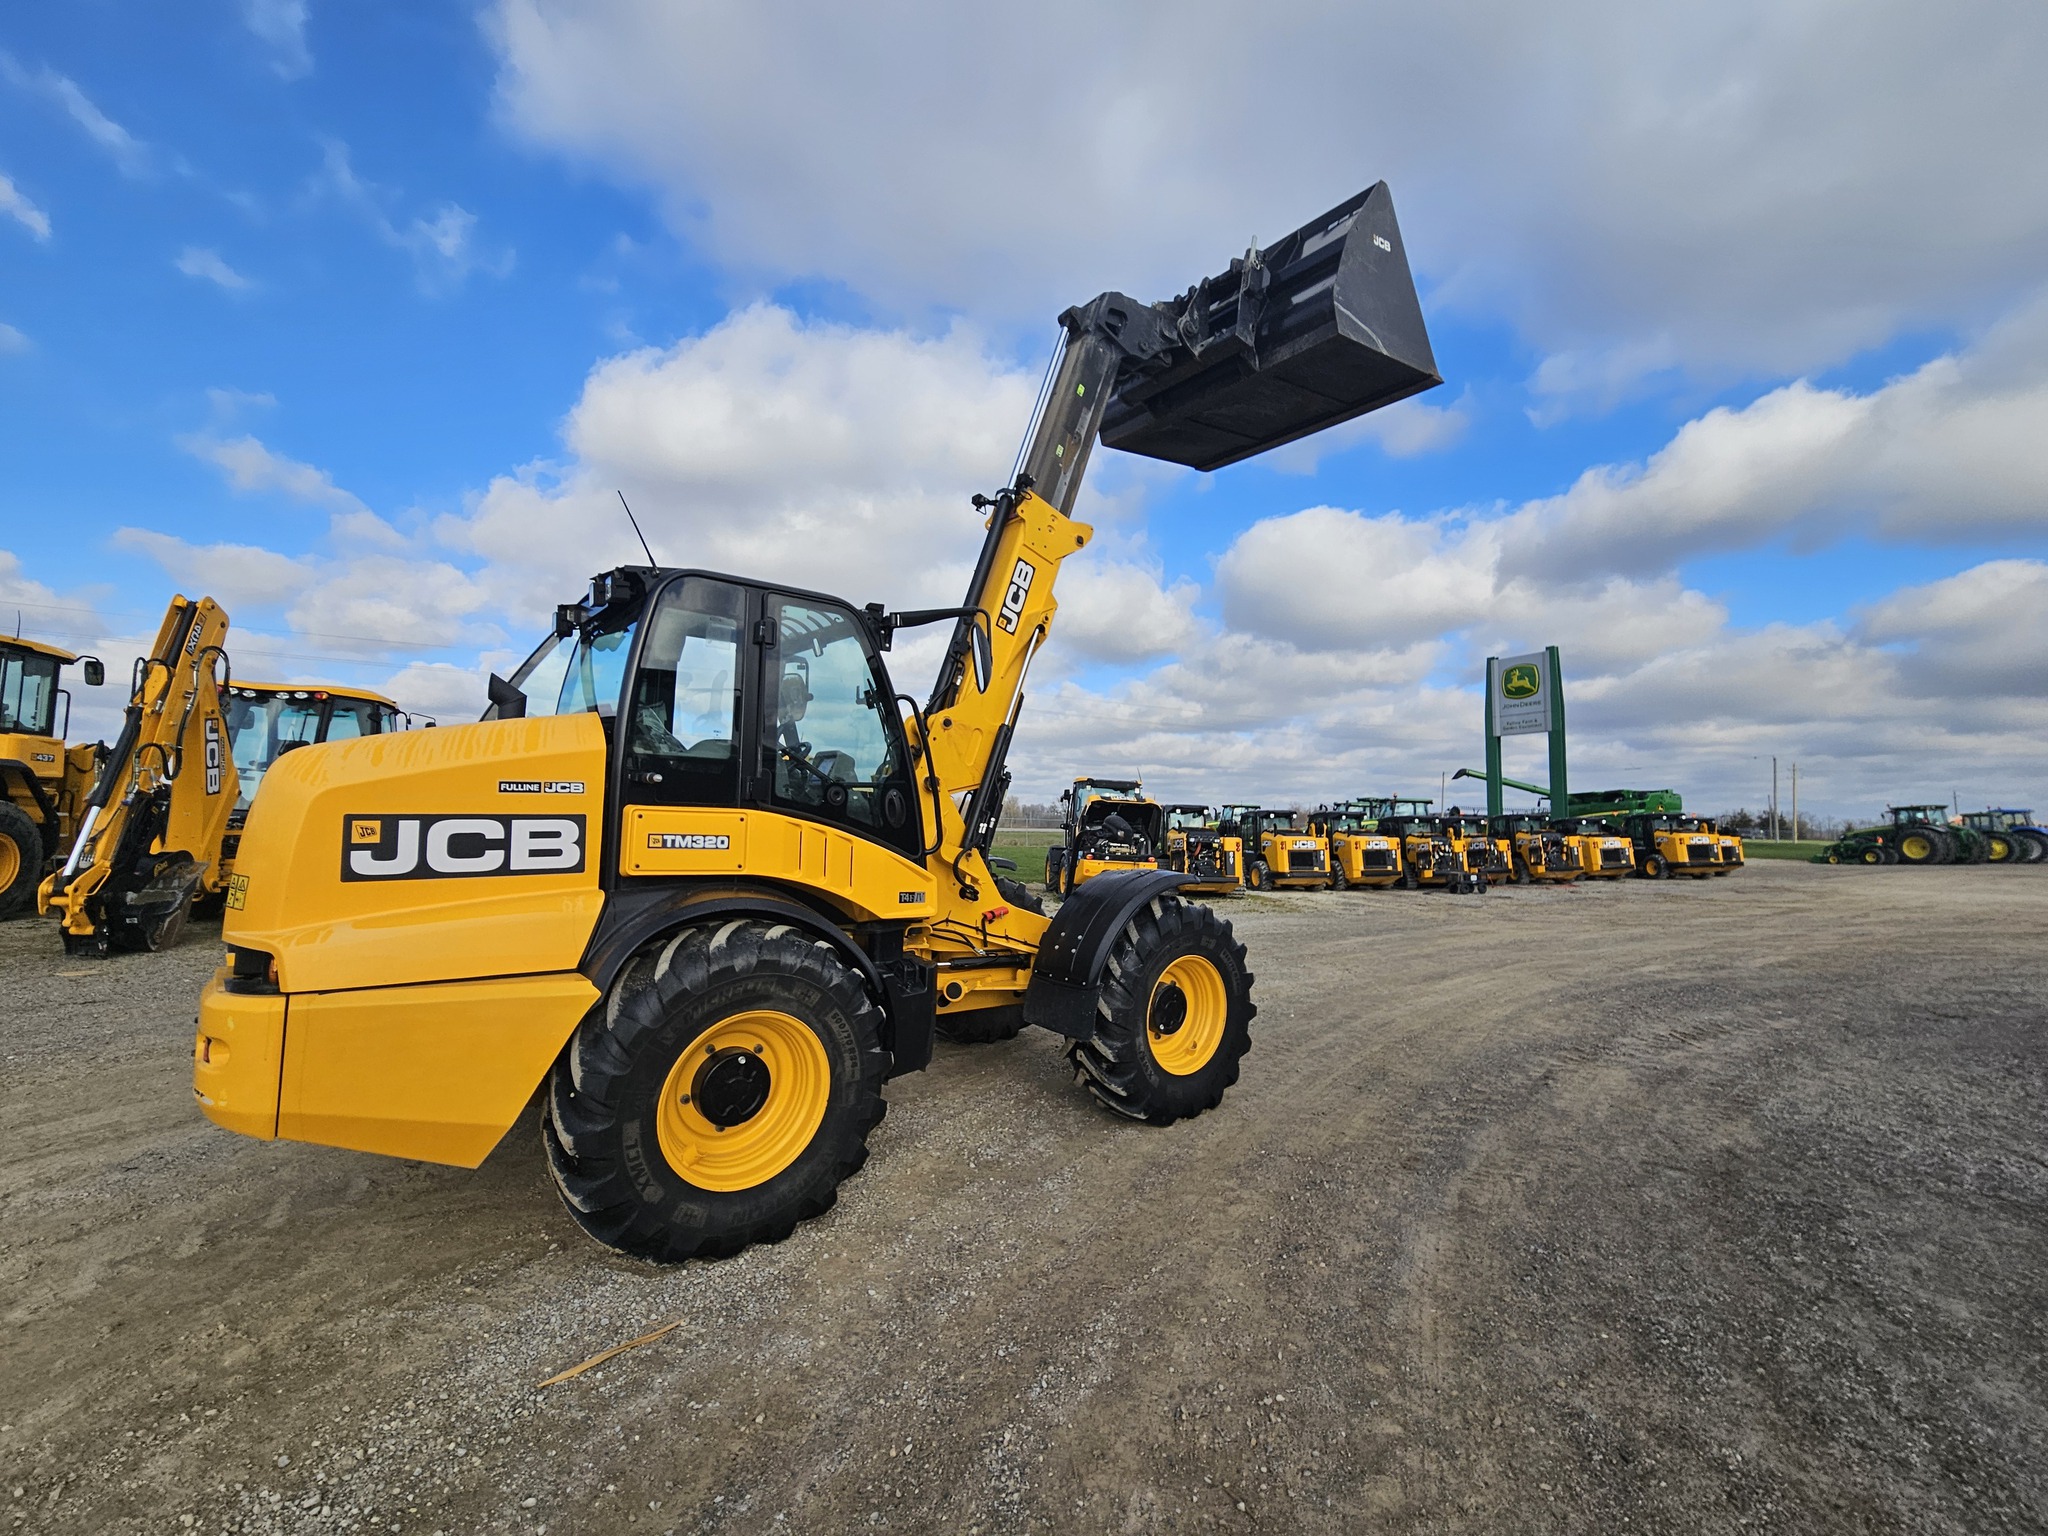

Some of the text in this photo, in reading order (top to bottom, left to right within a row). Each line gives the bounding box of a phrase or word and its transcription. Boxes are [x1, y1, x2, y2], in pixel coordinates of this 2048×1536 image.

[1373, 234, 1391, 252] JCB
[1001, 560, 1034, 633] JCB
[205, 720, 220, 794] JCB
[500, 782, 584, 793] FULLINE JCB
[359, 826, 377, 837] JCB
[350, 818, 581, 876] JCB
[663, 834, 729, 849] TM320
[1293, 840, 1316, 849] JCB
[1366, 840, 1388, 850] JCB
[1469, 842, 1486, 850] JCB
[624, 1138, 655, 1192] XMCL
